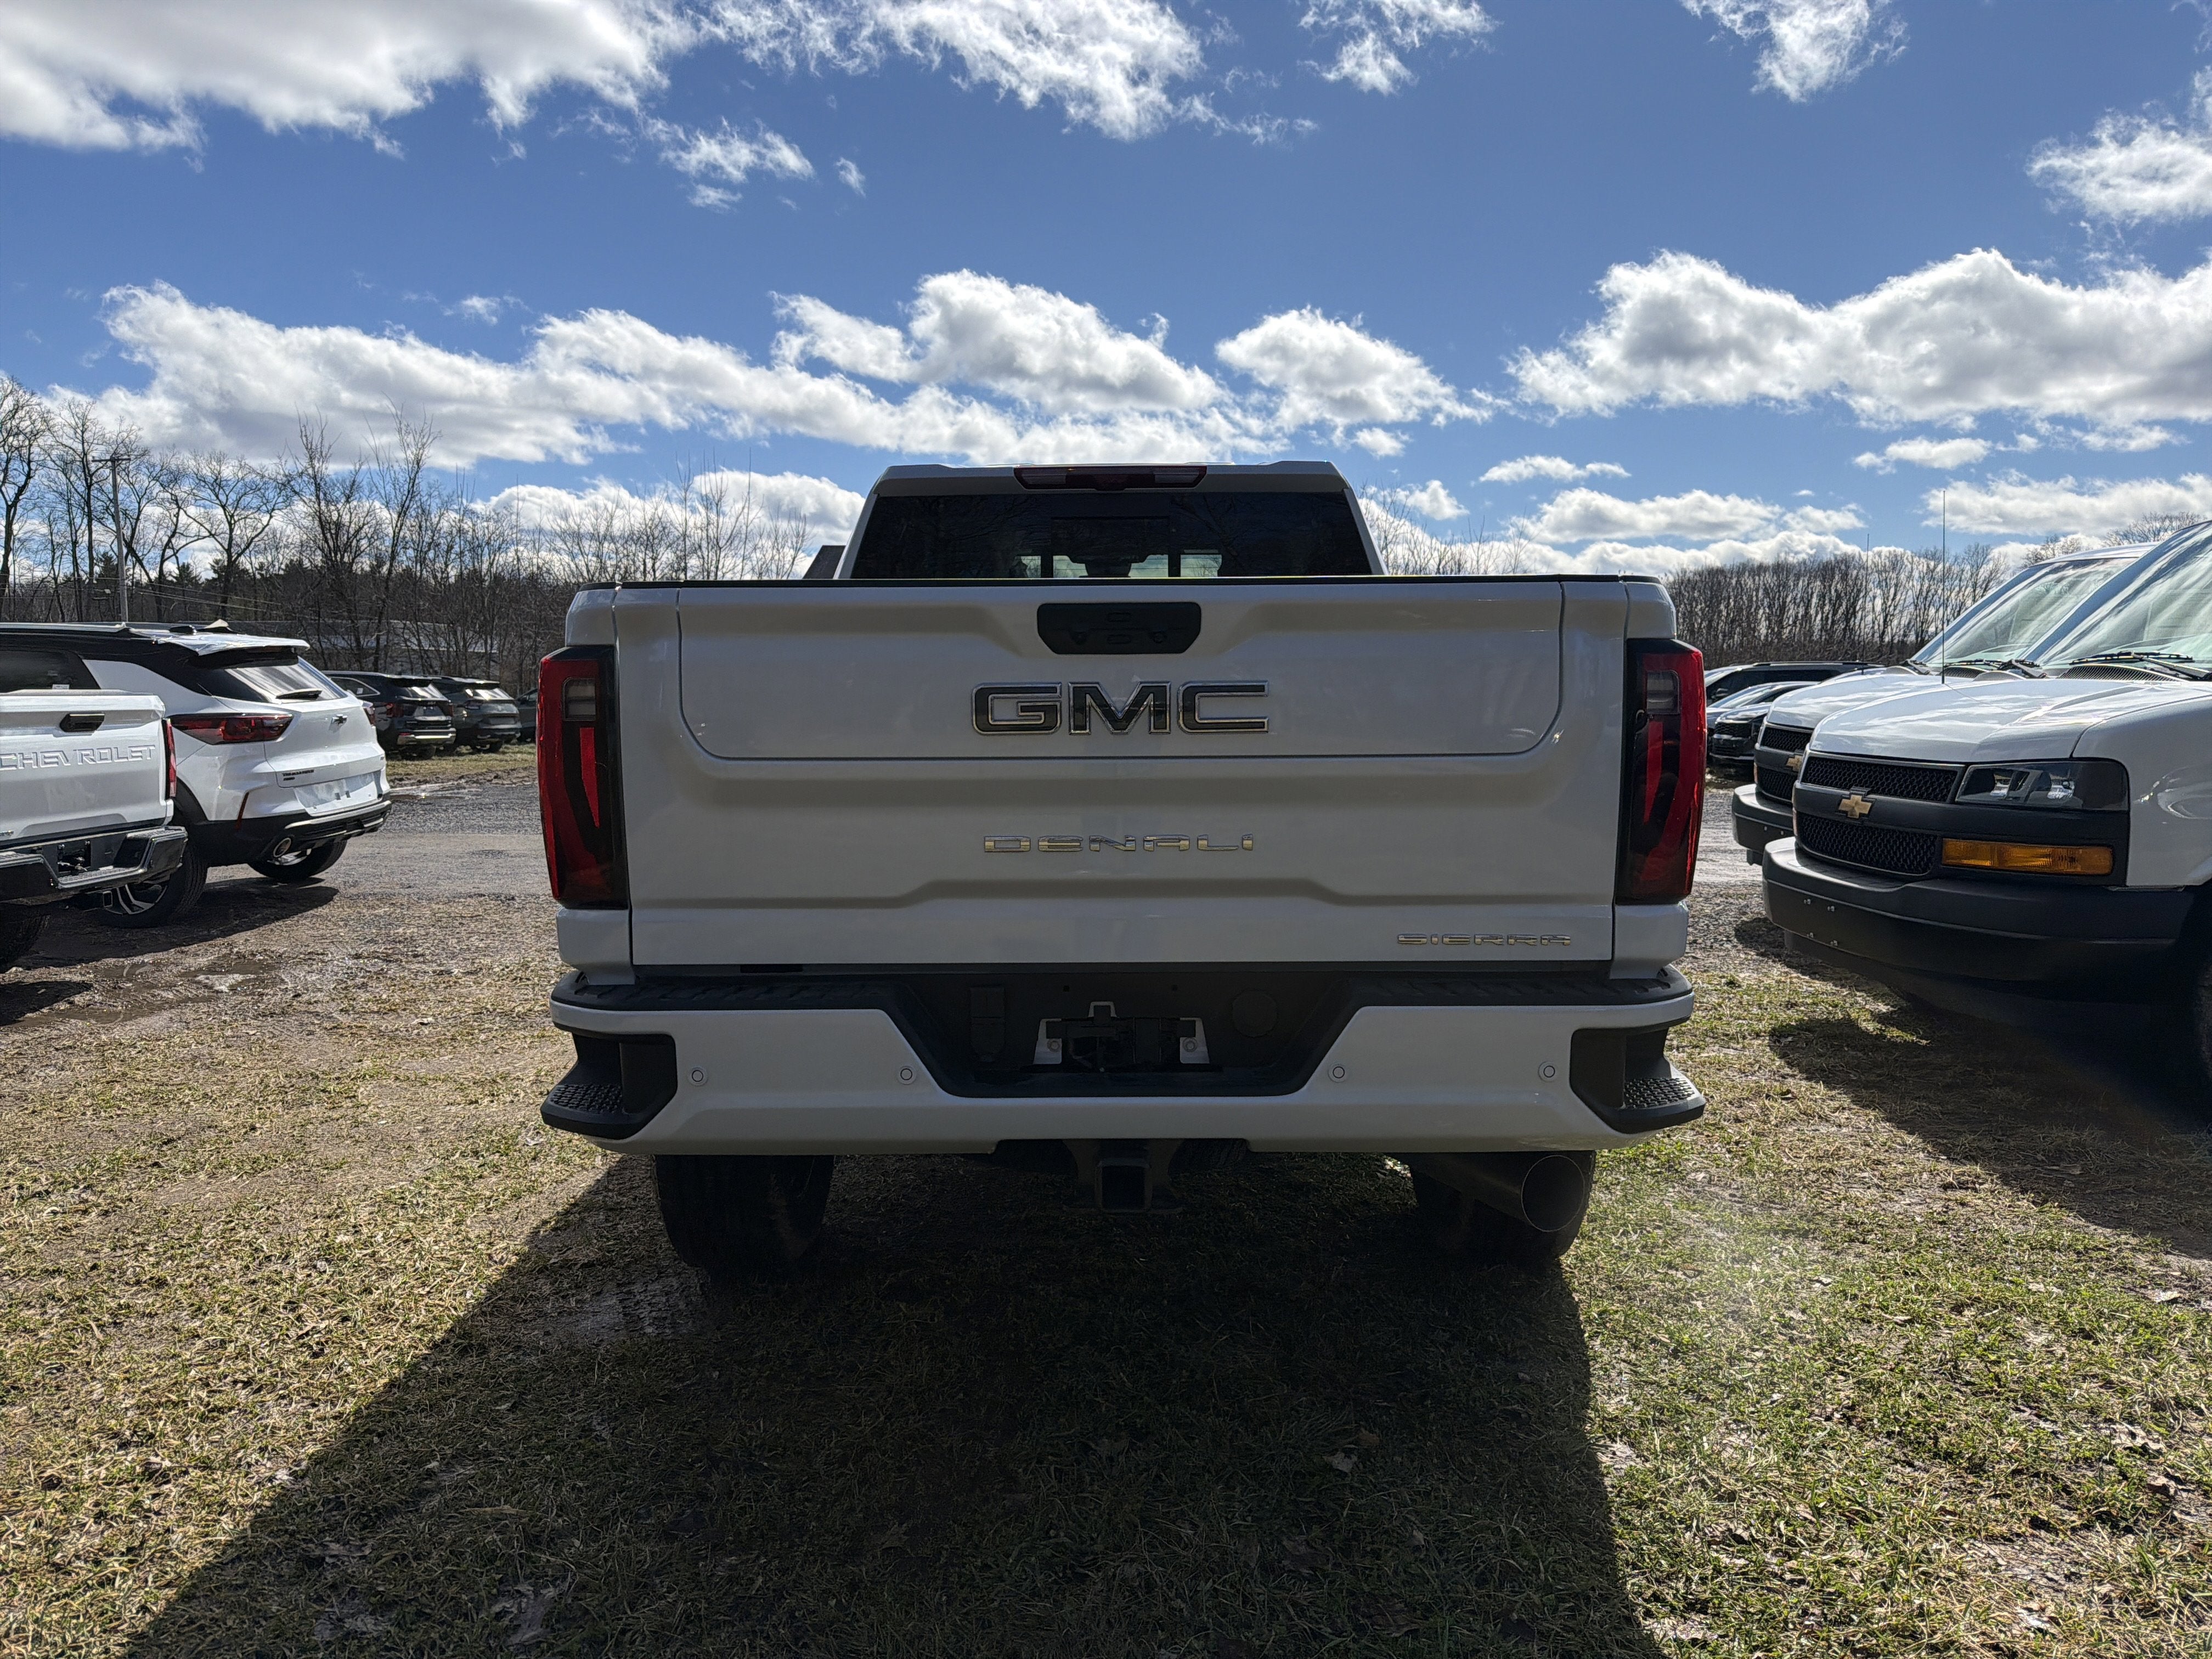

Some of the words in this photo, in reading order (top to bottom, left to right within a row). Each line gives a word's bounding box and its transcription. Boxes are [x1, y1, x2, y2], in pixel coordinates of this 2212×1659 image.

[972, 681, 1268, 735] GMC
[0, 744, 155, 770] CHEVROLET
[984, 834, 1253, 852] DENALI
[1397, 934, 1571, 945] SIERRA
